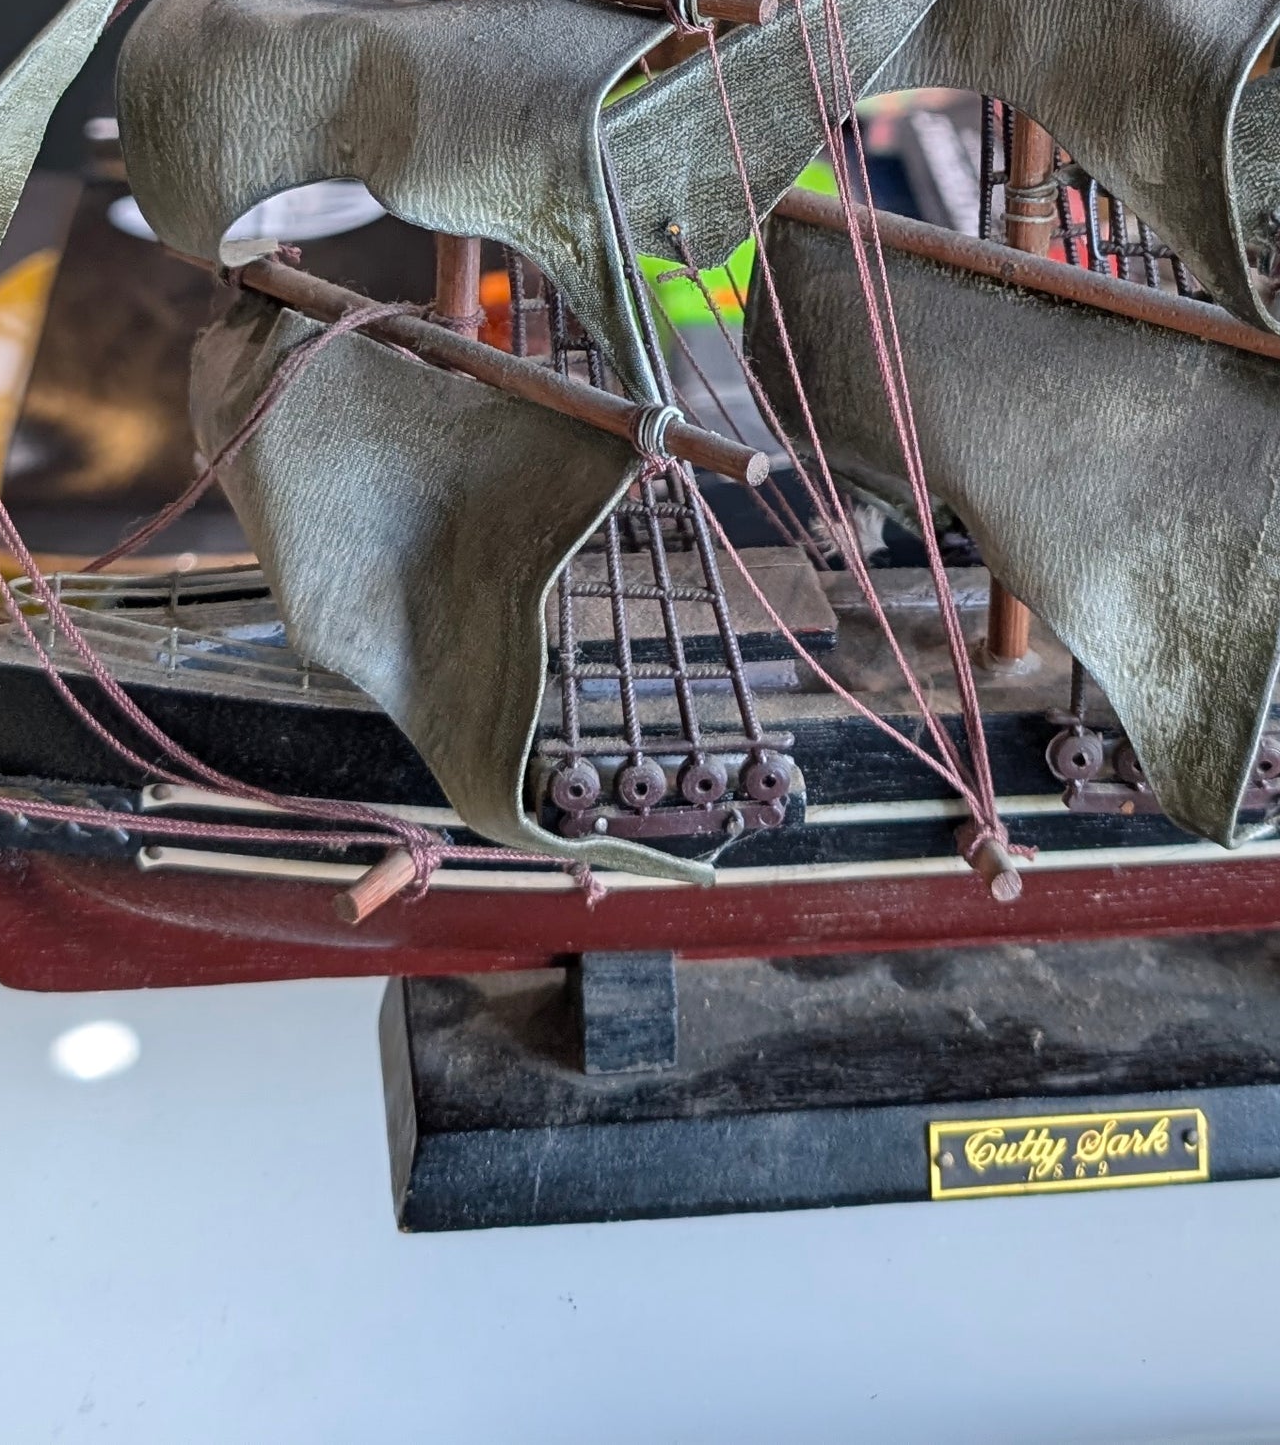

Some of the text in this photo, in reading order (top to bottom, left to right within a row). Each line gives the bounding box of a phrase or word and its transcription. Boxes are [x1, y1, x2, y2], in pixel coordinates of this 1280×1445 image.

[964, 1117, 1170, 1176] Cutty Sark
[1027, 1160, 1109, 1181] 1869
